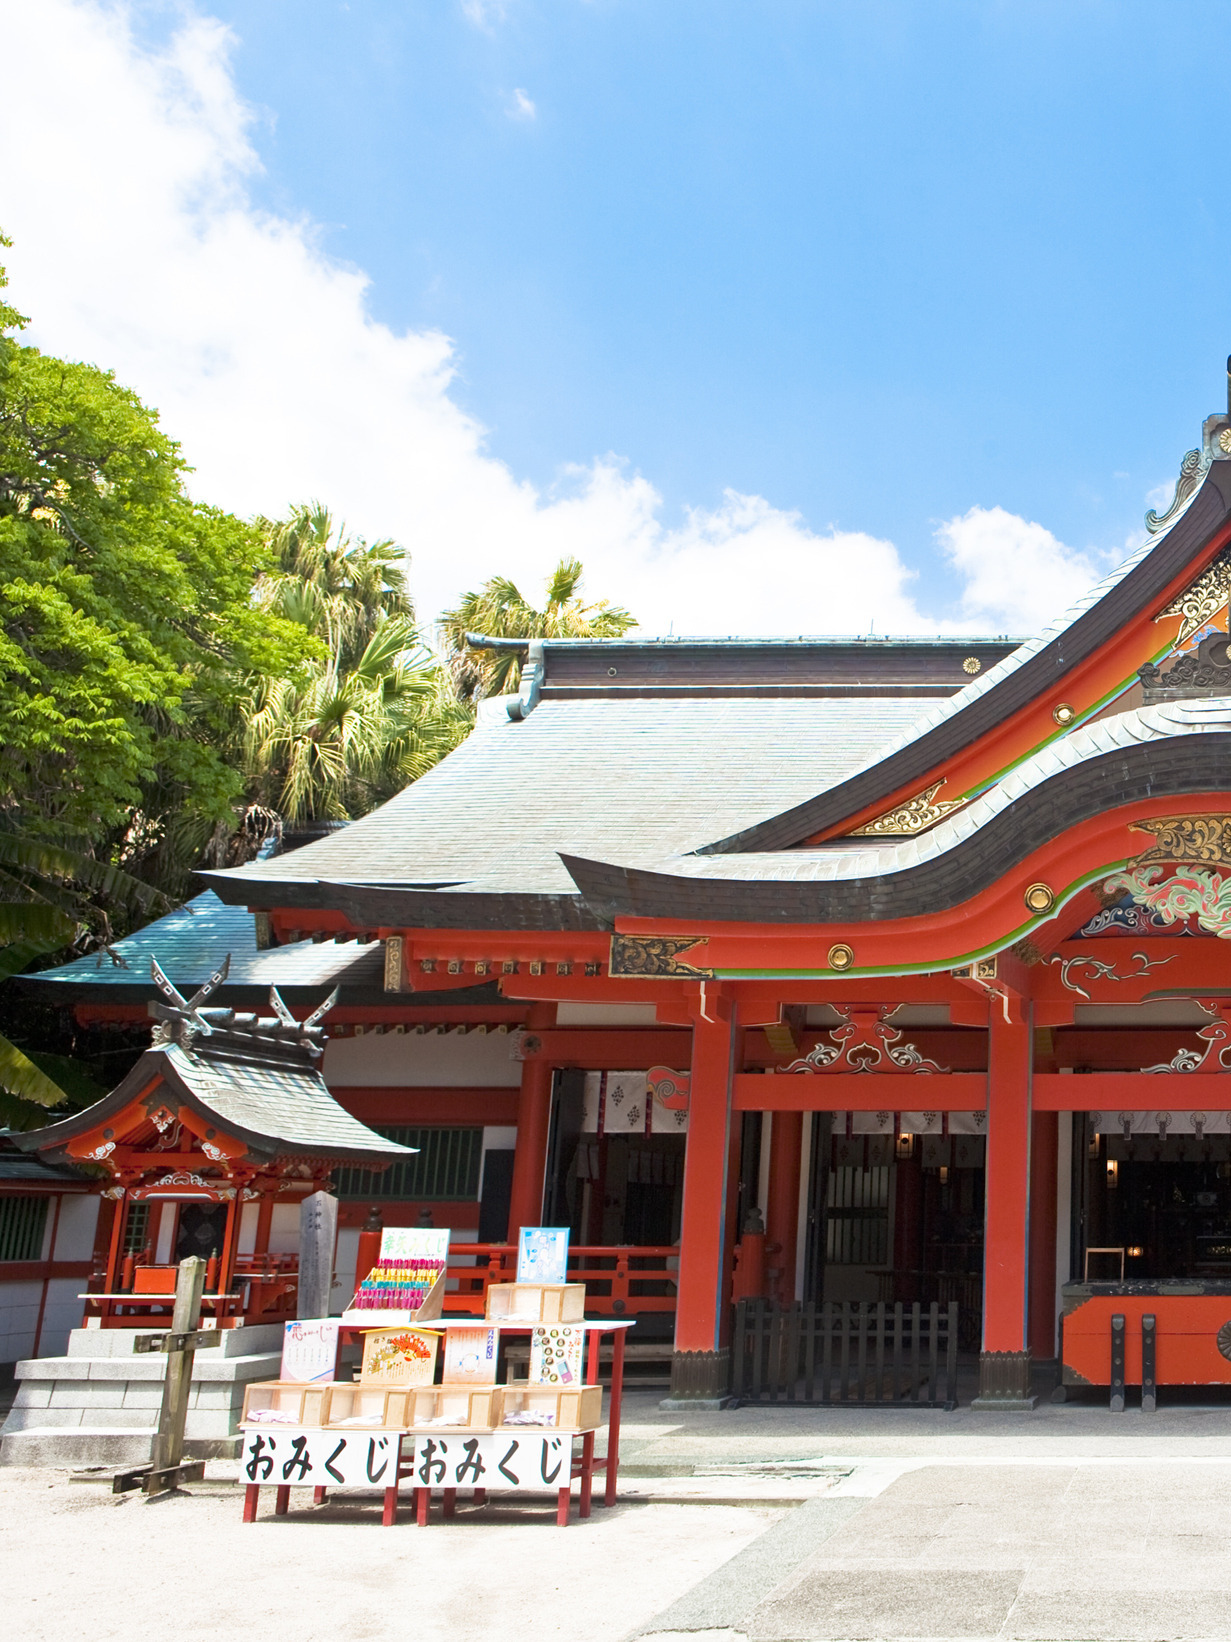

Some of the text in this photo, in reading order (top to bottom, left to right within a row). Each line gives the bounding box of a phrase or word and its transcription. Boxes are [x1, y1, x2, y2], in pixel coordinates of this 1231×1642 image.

[246, 1434, 388, 1484] おみくじ
[418, 1437, 562, 1485] おみくじ
